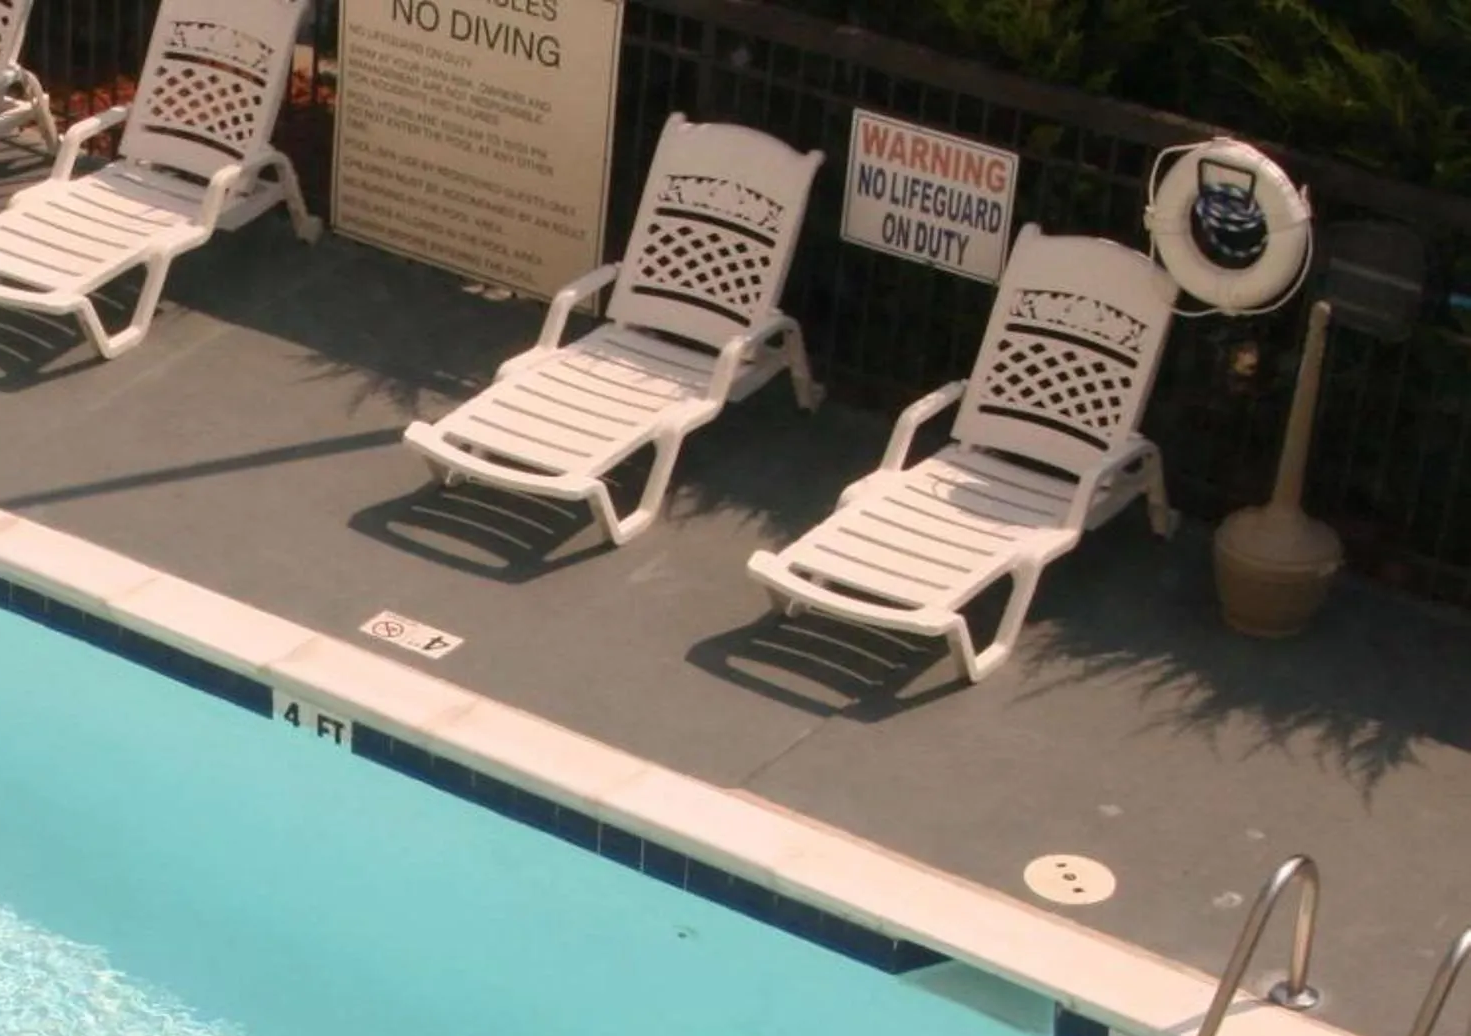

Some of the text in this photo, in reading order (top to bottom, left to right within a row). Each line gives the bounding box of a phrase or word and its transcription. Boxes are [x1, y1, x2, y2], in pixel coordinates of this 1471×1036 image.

[392, 0, 561, 68] NO DIVING
[862, 121, 1007, 193] WARNING
[858, 164, 1002, 234] NO LIFEGUARD
[882, 212, 970, 266] ON DUTY
[423, 635, 450, 651] 4
[283, 702, 345, 745] 4 FT
